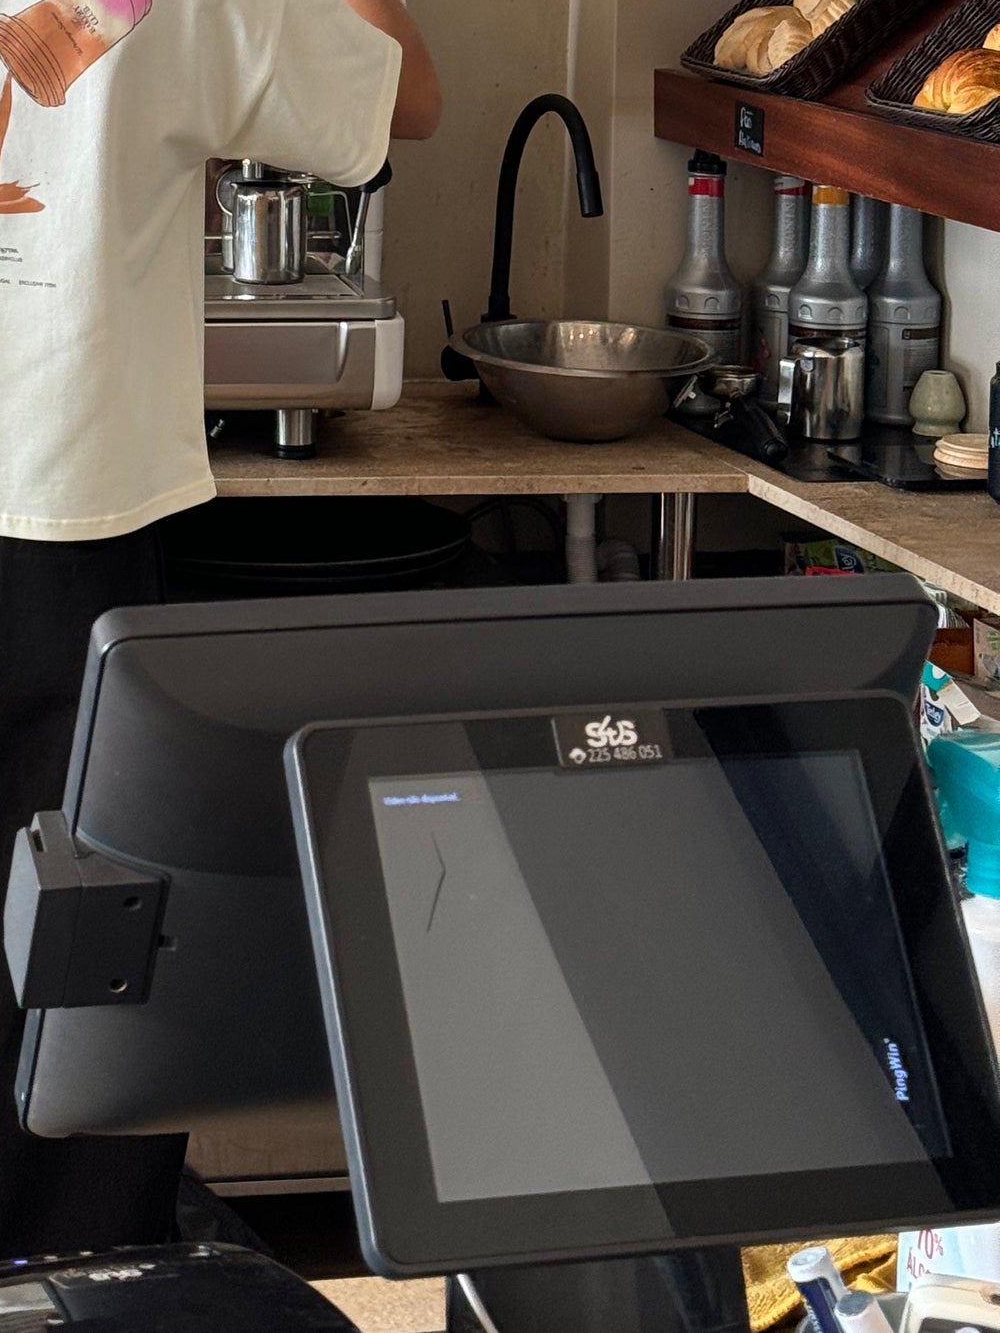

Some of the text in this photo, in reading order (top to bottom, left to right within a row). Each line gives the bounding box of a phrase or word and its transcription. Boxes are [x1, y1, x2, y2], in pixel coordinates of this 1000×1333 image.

[587, 744, 662, 763] 225 486 051
